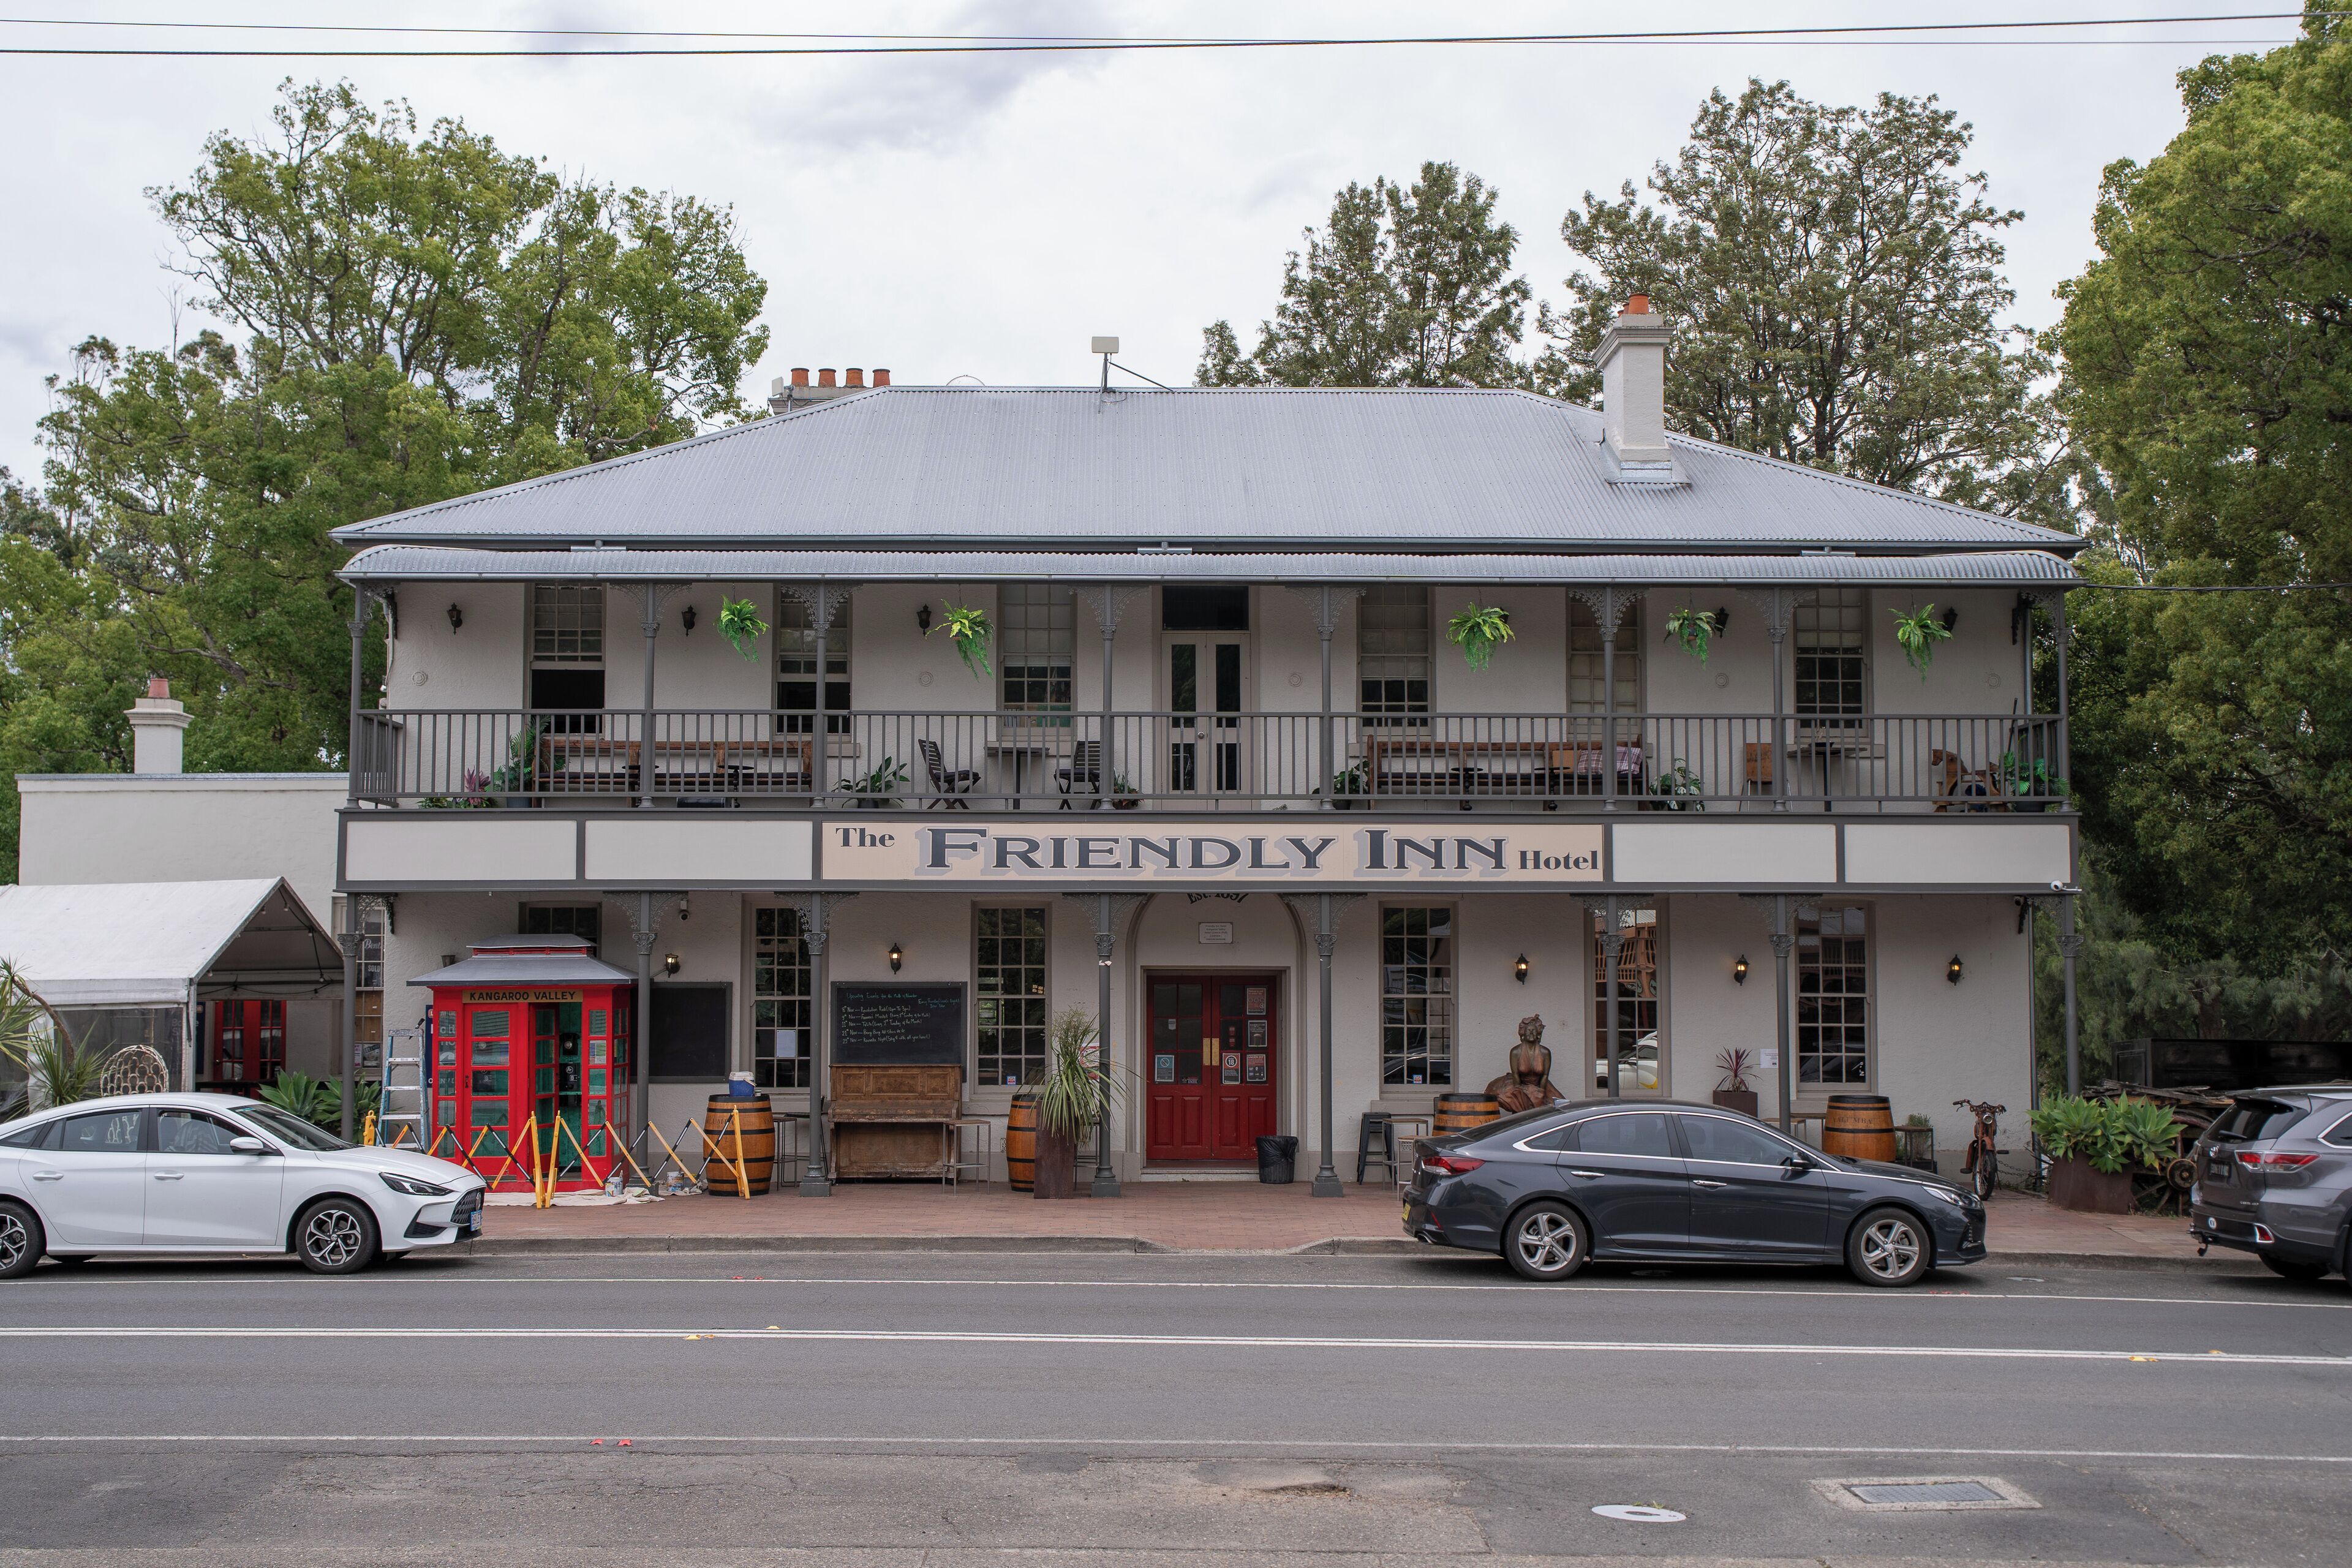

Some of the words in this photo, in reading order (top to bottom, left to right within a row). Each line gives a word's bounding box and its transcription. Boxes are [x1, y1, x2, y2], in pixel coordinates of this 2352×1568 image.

[835, 827, 895, 848] The
[925, 827, 1338, 870] FRIENDLY
[1365, 829, 1507, 870] INN
[1518, 849, 1599, 871] Hotel
[470, 992, 529, 1001] KANGAROO
[534, 991, 576, 1000] VALLEY
